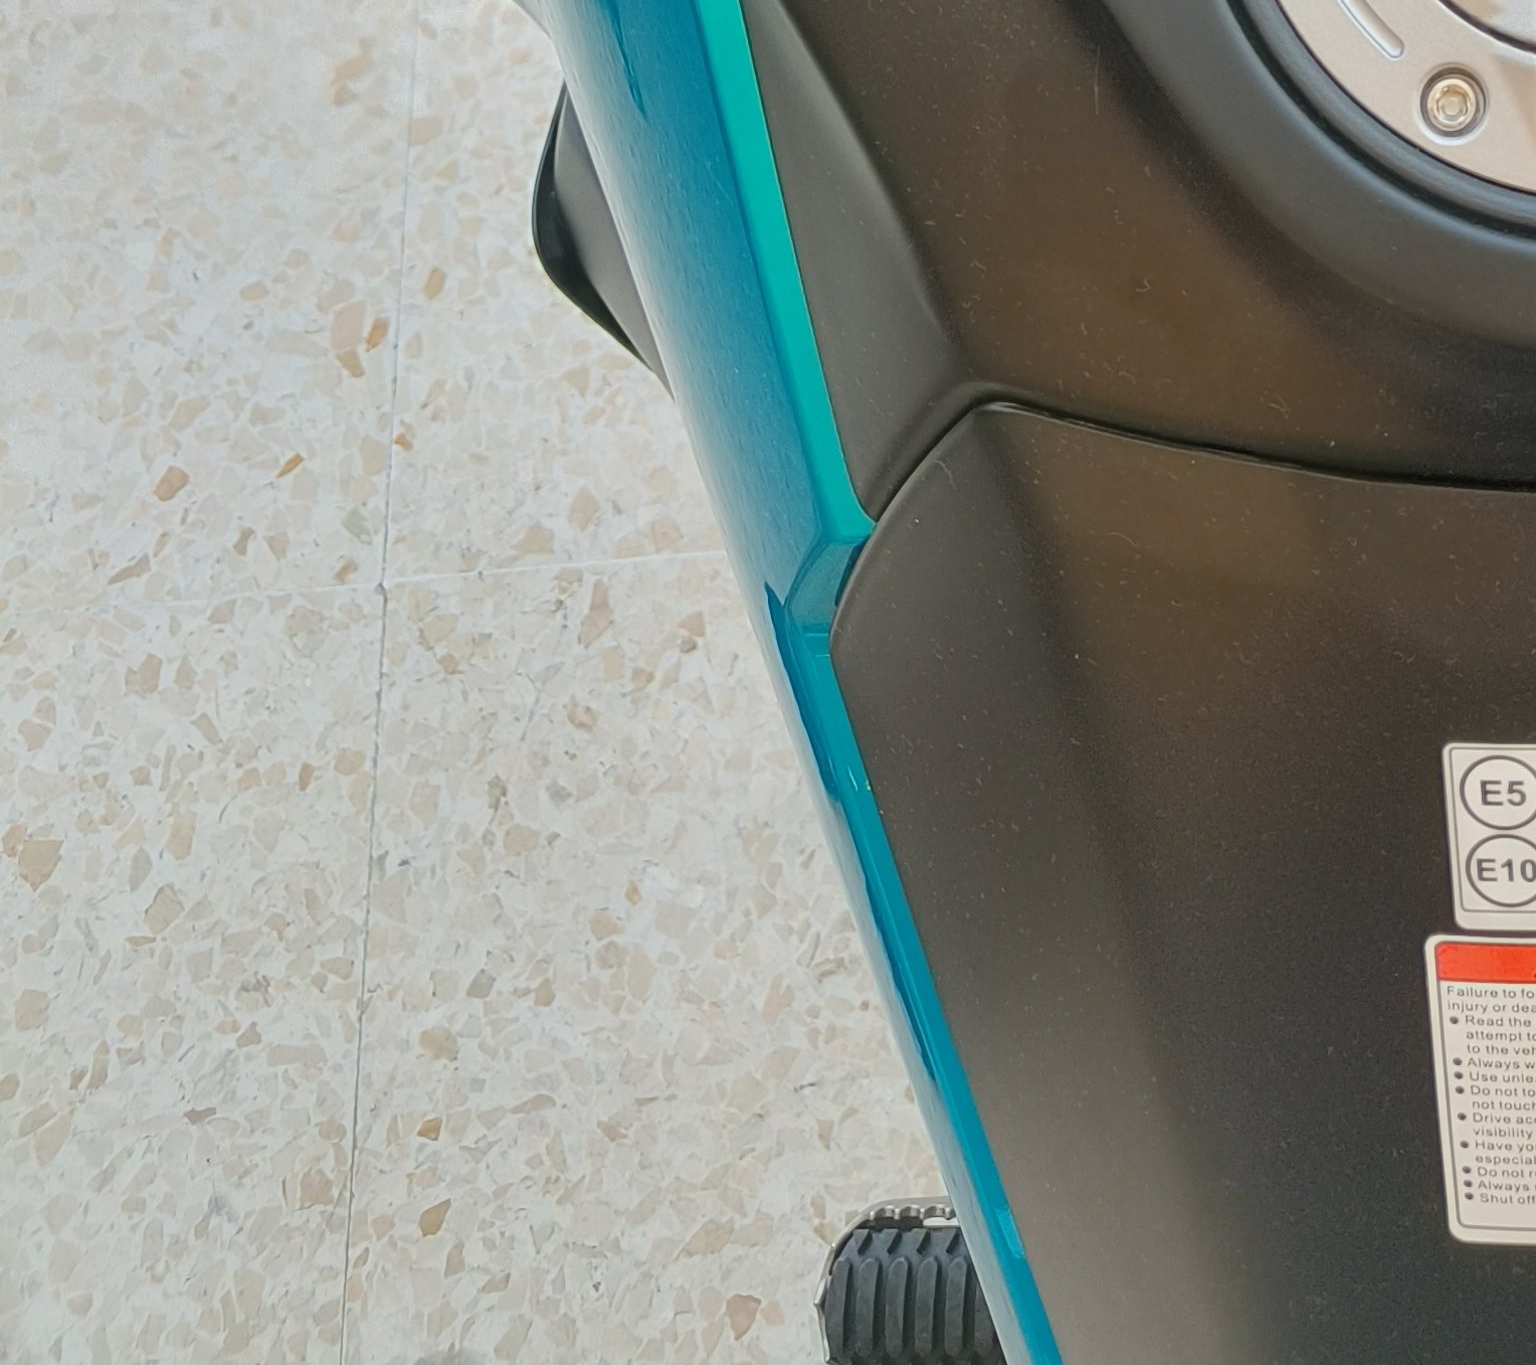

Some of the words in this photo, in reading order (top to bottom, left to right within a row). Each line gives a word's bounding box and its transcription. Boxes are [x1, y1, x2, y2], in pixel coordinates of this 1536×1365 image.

[1480, 779, 1527, 807] E5
[1446, 985, 1499, 998] Failure
[1501, 988, 1517, 999] to
[1447, 999, 1488, 1014] injury
[1491, 1004, 1507, 1013] or
[1464, 1014, 1504, 1027] Read
[1507, 1016, 1532, 1028] the
[1465, 1030, 1522, 1043] attempt
[1466, 1043, 1481, 1054] to
[1485, 1044, 1509, 1055] the
[1466, 1057, 1520, 1072] Always
[1468, 1070, 1498, 1082] Use
[1469, 1084, 1491, 1096] Do
[1494, 1087, 1518, 1097] not
[1471, 1100, 1495, 1110] not
[1472, 1112, 1511, 1124] Drive
[1472, 1126, 1533, 1140] visibility
[1474, 1139, 1513, 1151] Have
[1476, 1166, 1498, 1178] Do
[1501, 1169, 1525, 1178] not
[1477, 1179, 1530, 1196] Always
[1479, 1192, 1514, 1204] Shut
[1516, 1194, 1536, 1205] off
